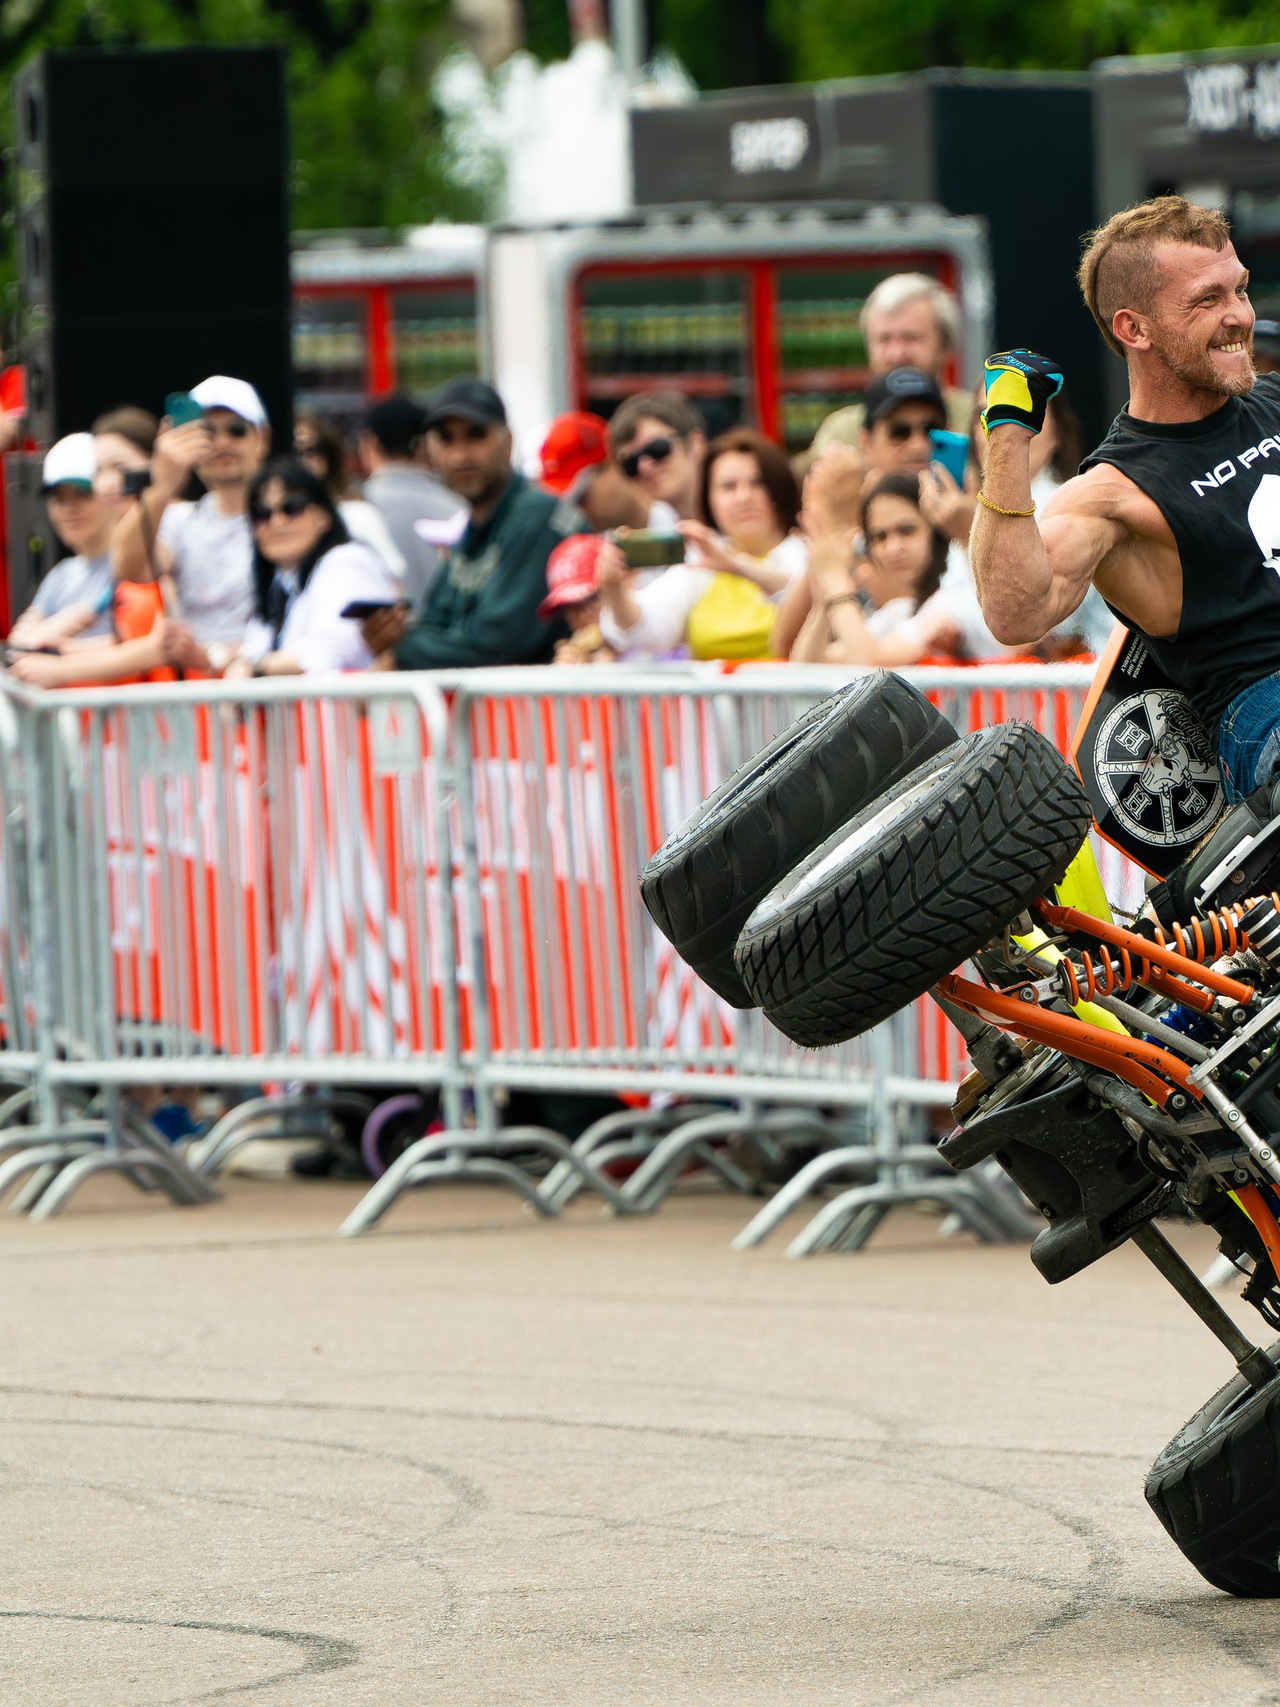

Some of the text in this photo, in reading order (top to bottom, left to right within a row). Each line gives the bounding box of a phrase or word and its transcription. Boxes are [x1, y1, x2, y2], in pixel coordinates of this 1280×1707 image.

[1190, 459, 1237, 497] NO
[1115, 719, 1151, 756] H
[1122, 782, 1153, 821] H
